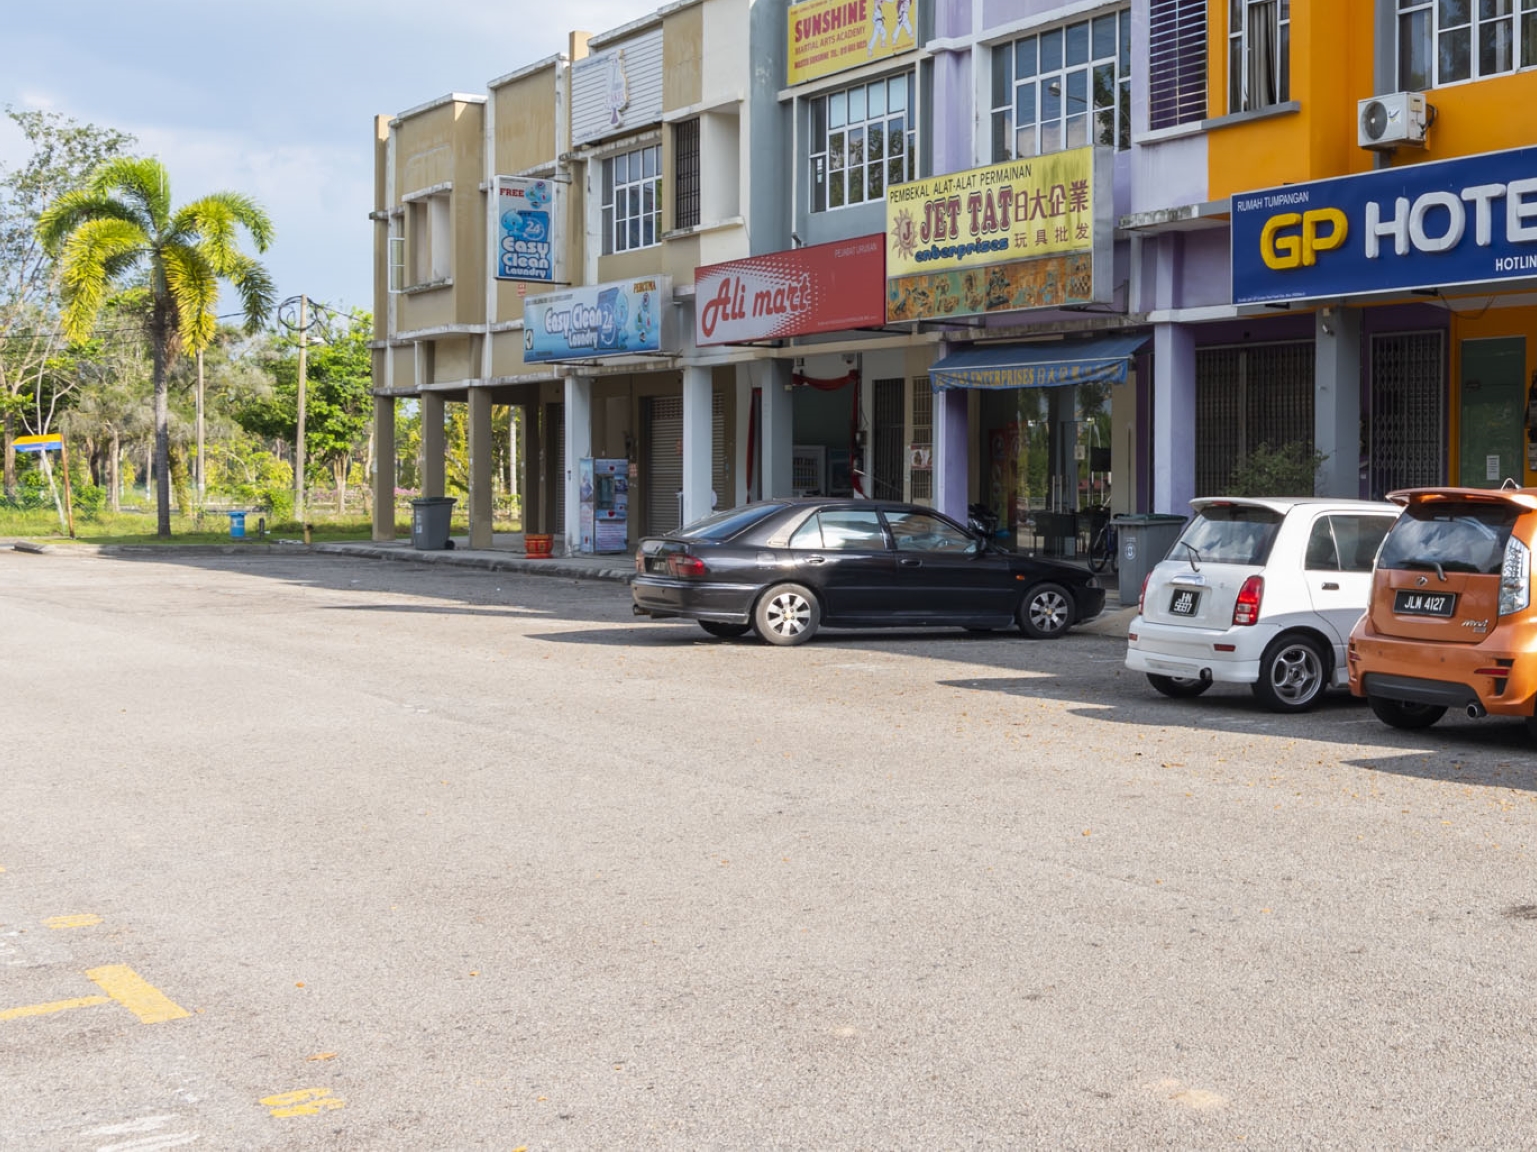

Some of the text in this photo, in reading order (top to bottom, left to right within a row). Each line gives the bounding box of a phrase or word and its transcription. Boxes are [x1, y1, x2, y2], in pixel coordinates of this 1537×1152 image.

[795, 41, 819, 56] MARTIAL
[820, 34, 836, 47] ARTS
[837, 25, 865, 41] ACADEMY
[500, 187, 525, 198] FREE
[890, 163, 1032, 204] PEMBEKAL ALAT-ALAT PERMAINAN
[1014, 179, 1089, 223] 日大企業
[1237, 190, 1309, 213] RUMAH TUMPANGAN
[920, 184, 1013, 244] JET TAT
[526, 221, 541, 232] 24
[1014, 223, 1089, 249] 玩具批发
[1260, 206, 1349, 270] GP
[502, 237, 550, 259] Easy
[914, 236, 1009, 263] enterprises
[502, 252, 550, 269] Clean
[505, 266, 547, 279] Laundry
[702, 274, 811, 338] Ali mart
[545, 303, 602, 339] Easy Clean
[603, 311, 614, 330] 24
[569, 330, 598, 350] Laundry
[970, 368, 1034, 386] ENTERPRISES
[1424, 597, 1446, 612] 4127
